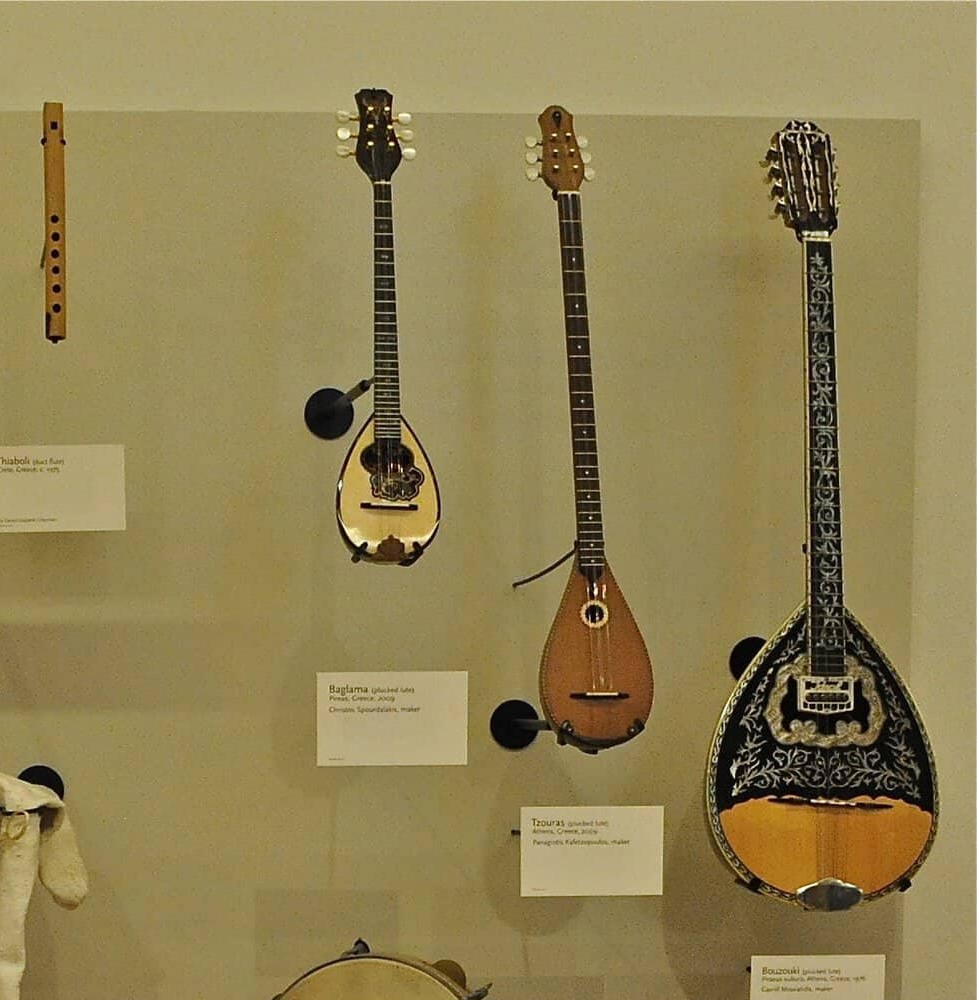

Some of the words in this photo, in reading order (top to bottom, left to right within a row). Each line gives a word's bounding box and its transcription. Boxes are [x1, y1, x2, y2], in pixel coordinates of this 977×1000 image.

[329, 684, 368, 696] Baglama
[531, 818, 565, 826] Tzouras
[762, 966, 800, 975] Bouzouki
